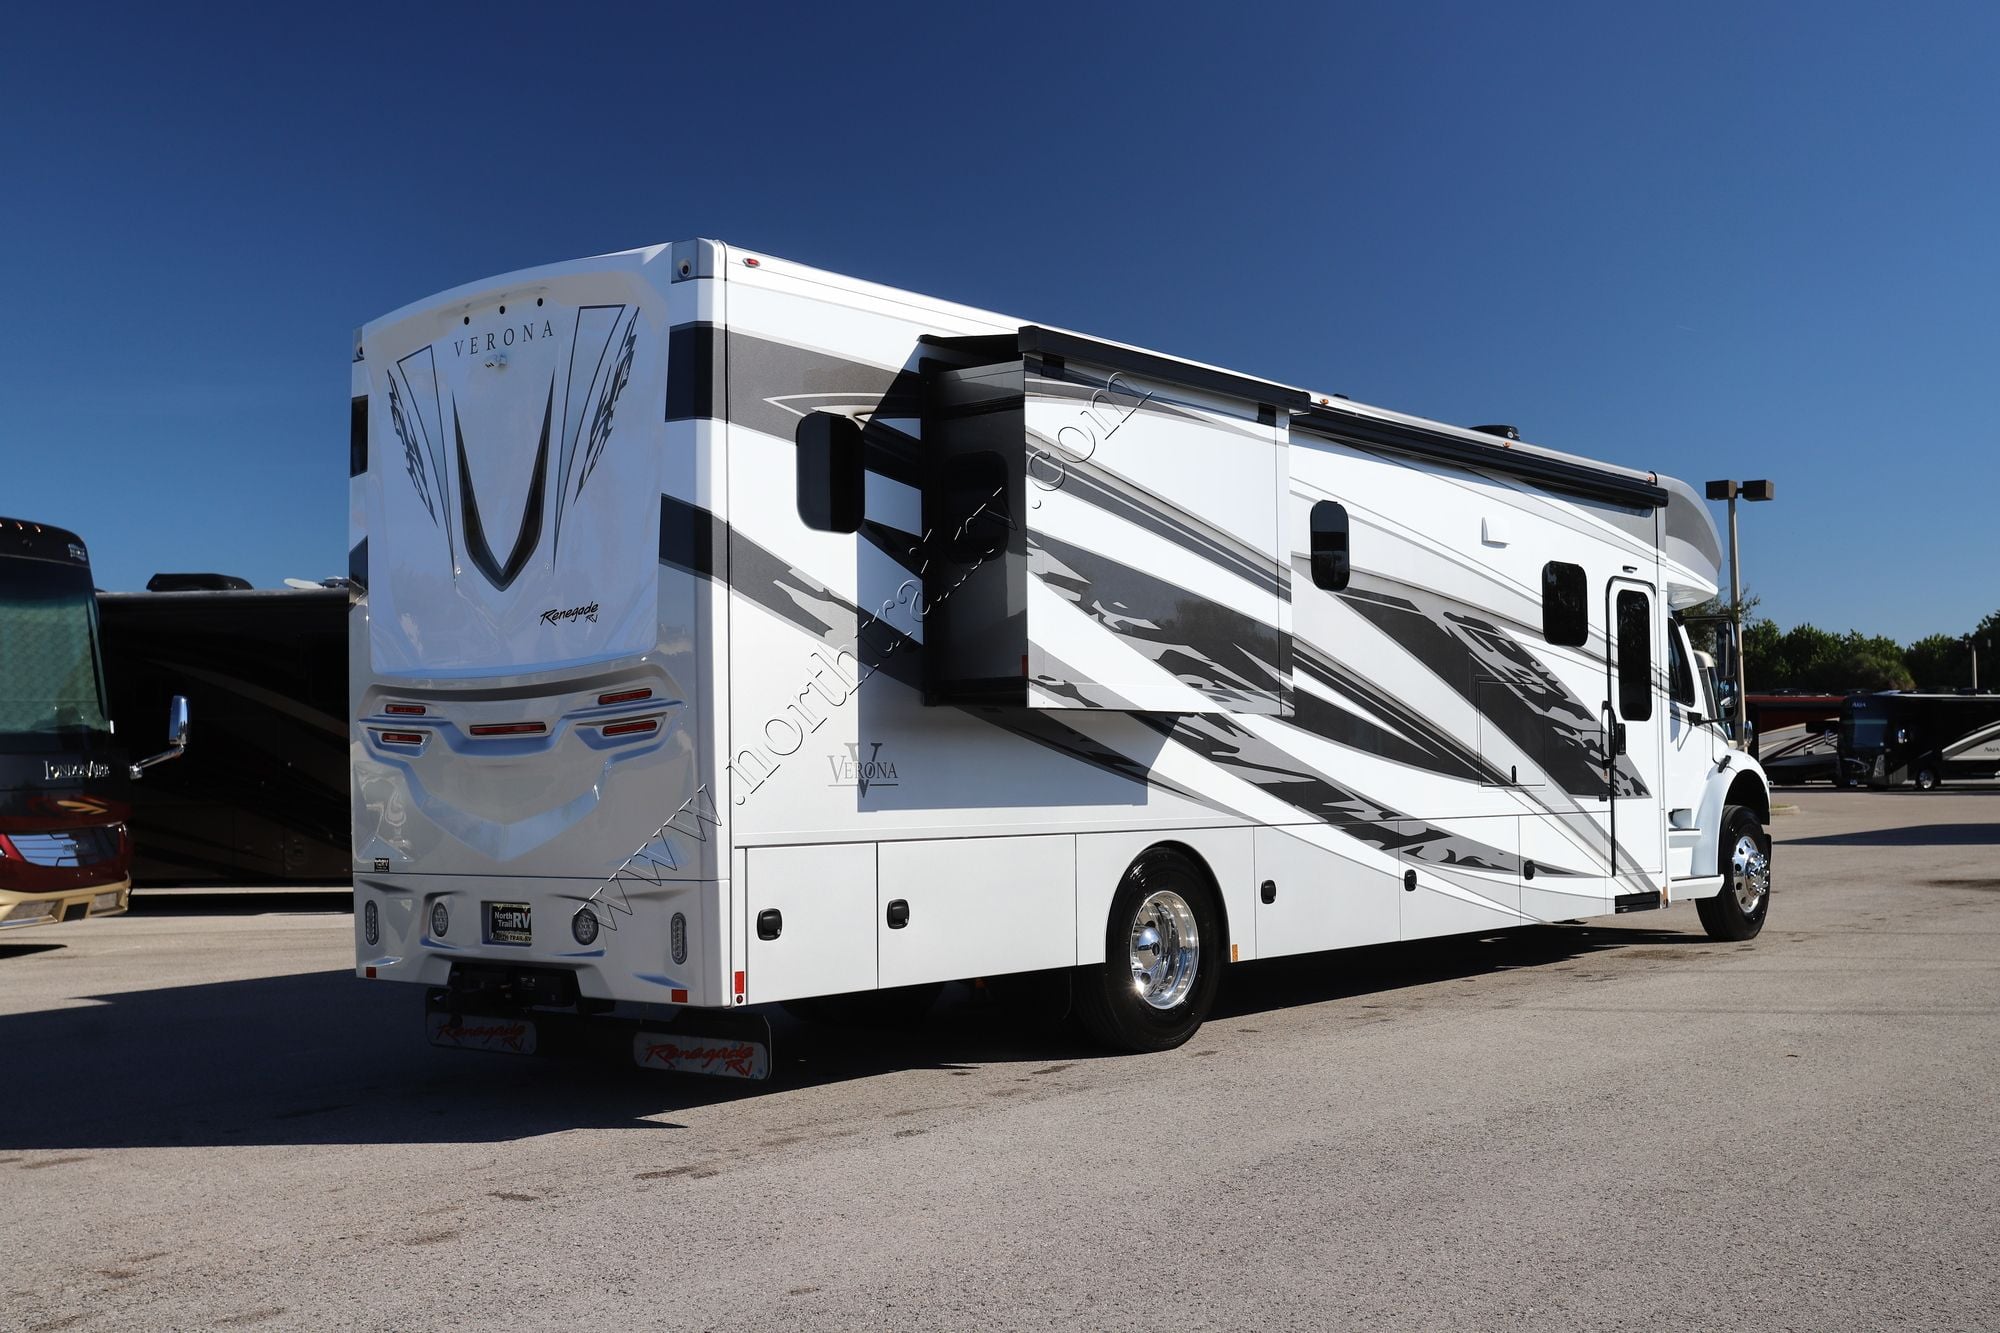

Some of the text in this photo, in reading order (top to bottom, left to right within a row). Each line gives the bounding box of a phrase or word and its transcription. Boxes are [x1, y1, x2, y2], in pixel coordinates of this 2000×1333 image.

[454, 320, 554, 358] VERONA
[540, 601, 599, 626] Renegade
[585, 614, 599, 623] RV
[826, 754, 899, 785] VERONA
[494, 911, 513, 920] North
[497, 919, 513, 928] Trail
[513, 912, 531, 929] RV
[645, 1043, 754, 1069] Renegade
[725, 1059, 753, 1077] RV
